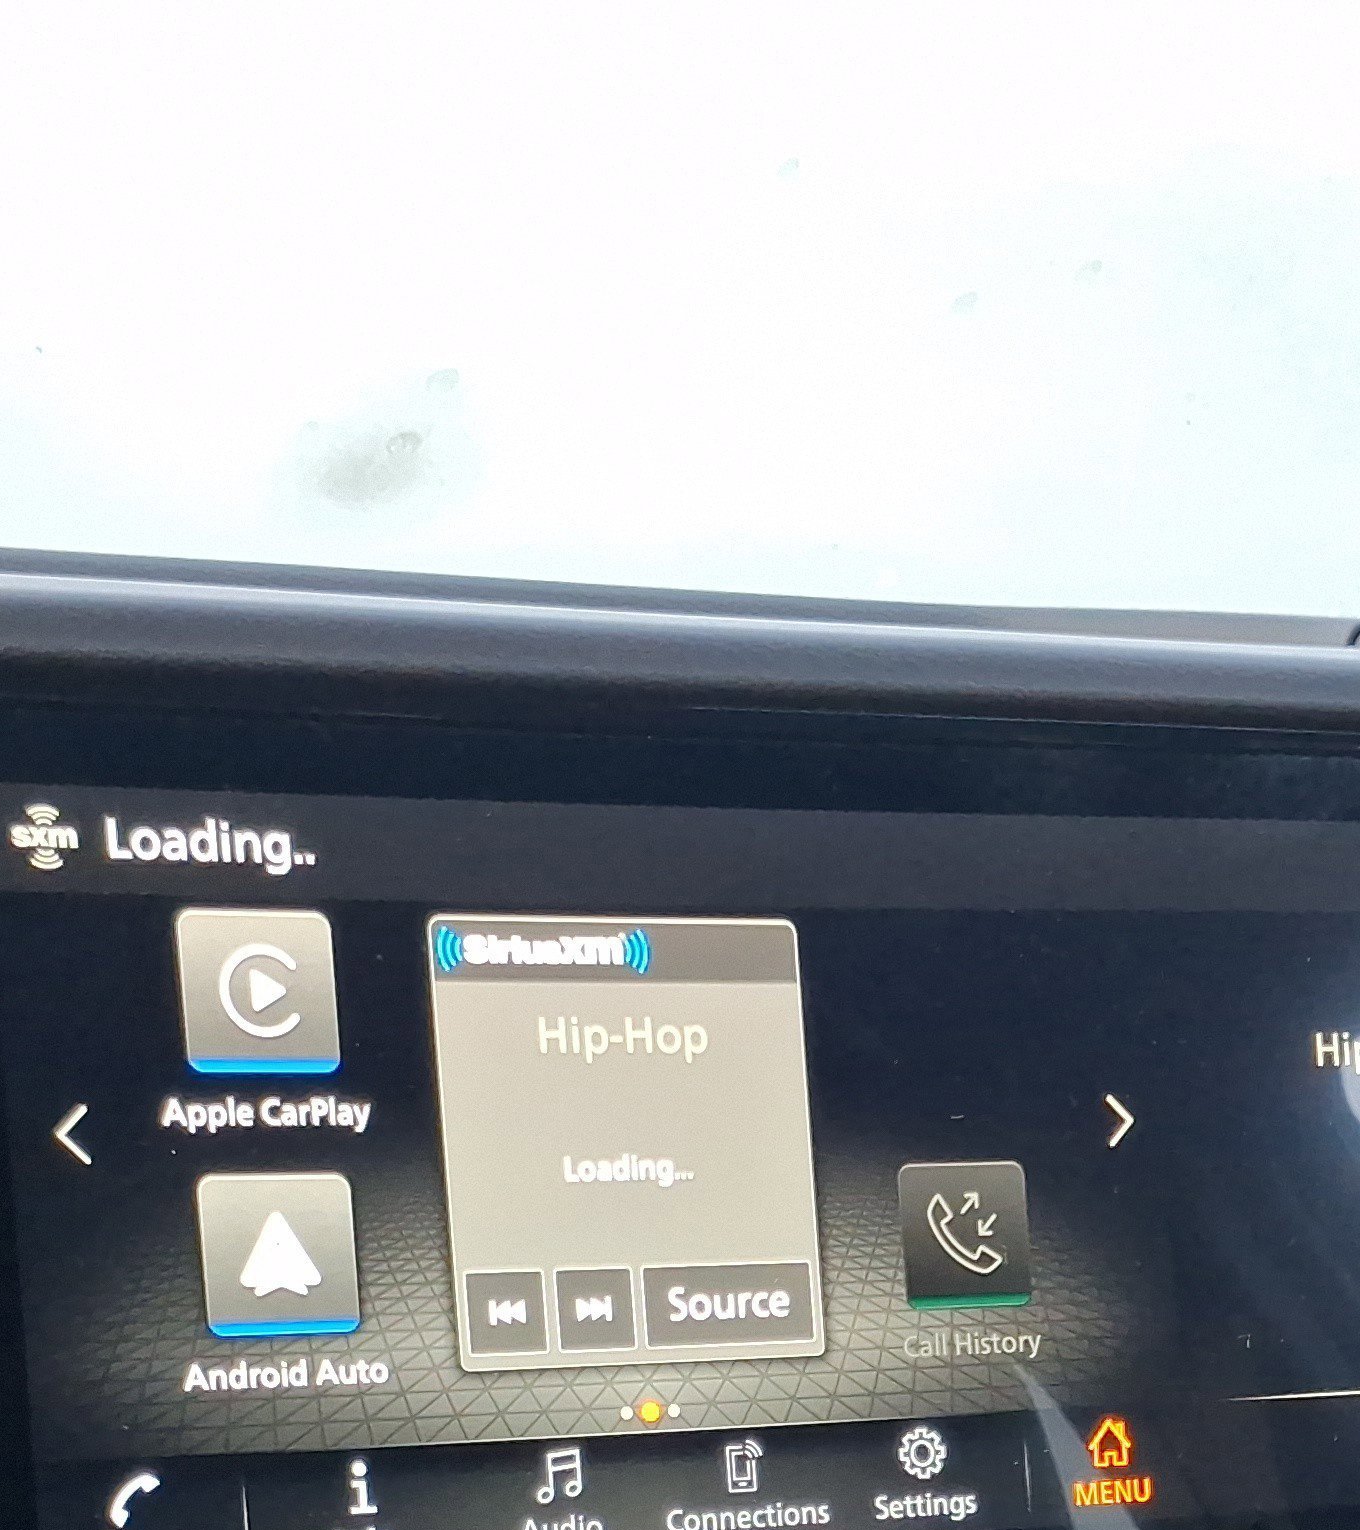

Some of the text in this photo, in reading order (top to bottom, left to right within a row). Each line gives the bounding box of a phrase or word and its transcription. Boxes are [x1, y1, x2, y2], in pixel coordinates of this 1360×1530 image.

[463, 932, 625, 966] SiriusXM
[537, 1017, 709, 1064] Hip-Hop
[161, 1096, 371, 1134] Apple CarPlay
[563, 1155, 695, 1186] Loading...
[666, 1286, 791, 1323] Source
[903, 1332, 1041, 1358] Call History
[183, 1358, 390, 1395] Android Auto
[874, 1493, 978, 1521] Settings
[1073, 1478, 1151, 1507] MENU
